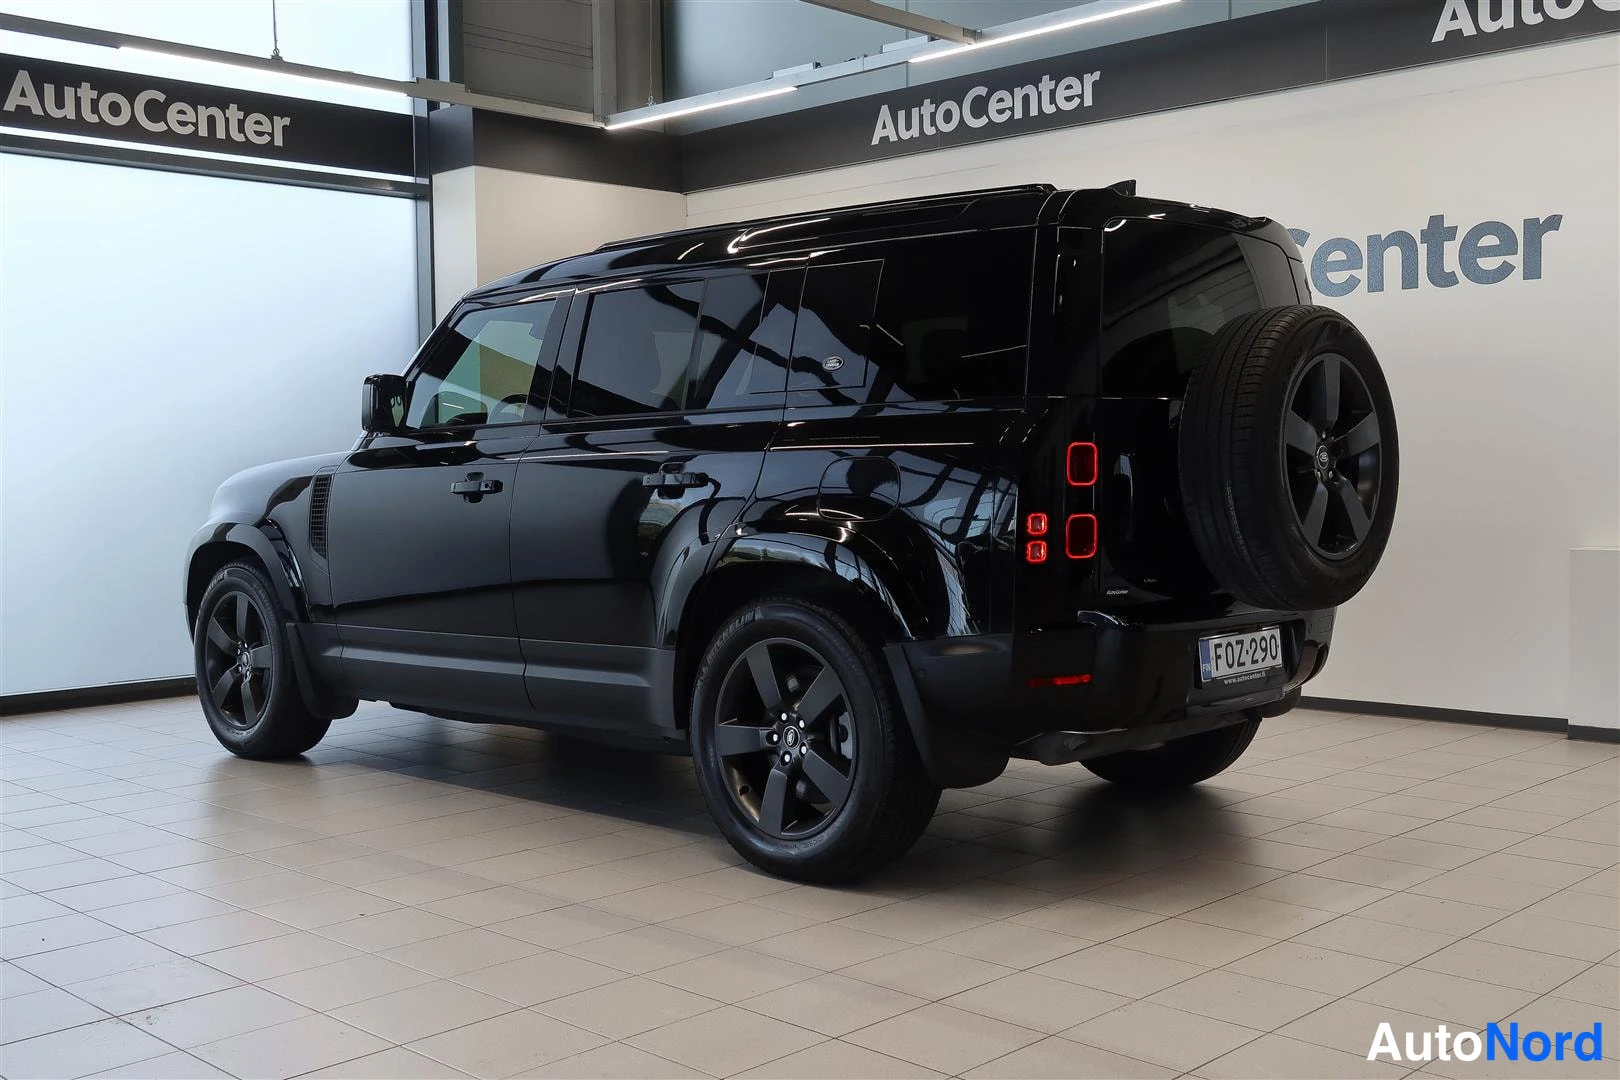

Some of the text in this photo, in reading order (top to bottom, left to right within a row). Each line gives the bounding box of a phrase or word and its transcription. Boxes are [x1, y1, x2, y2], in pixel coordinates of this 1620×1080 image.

[1431, 0, 1620, 43] Aut
[3, 70, 291, 147] AutoCenter
[871, 71, 1100, 145] AutoCenter
[1286, 214, 1563, 298] enter
[1214, 634, 1278, 671] FOZ-290
[1224, 671, 1266, 684] www.autocenter.fi
